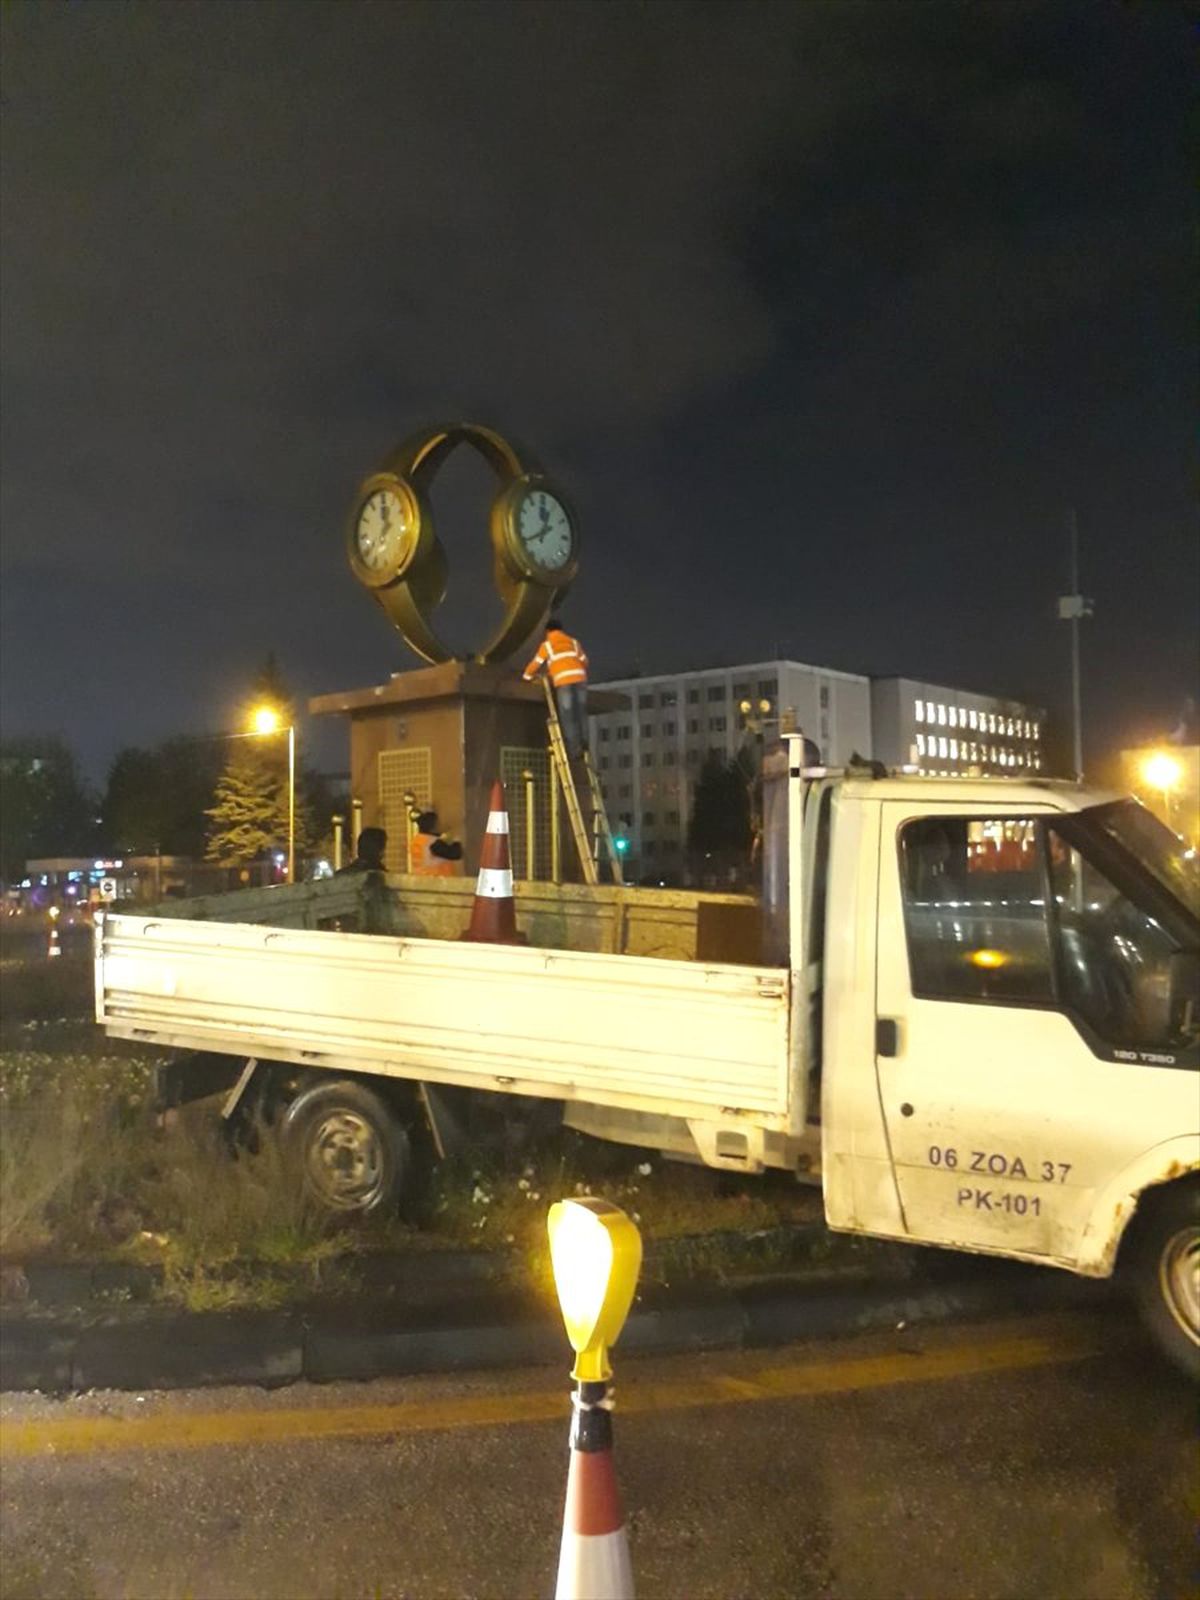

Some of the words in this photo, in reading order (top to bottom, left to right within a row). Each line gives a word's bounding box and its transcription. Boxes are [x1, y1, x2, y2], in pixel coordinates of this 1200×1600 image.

[928, 1145, 958, 1169] 06
[970, 1152, 1027, 1177] ZOA
[1041, 1162, 1072, 1184] 37
[957, 1188, 1041, 1216] PK-101
